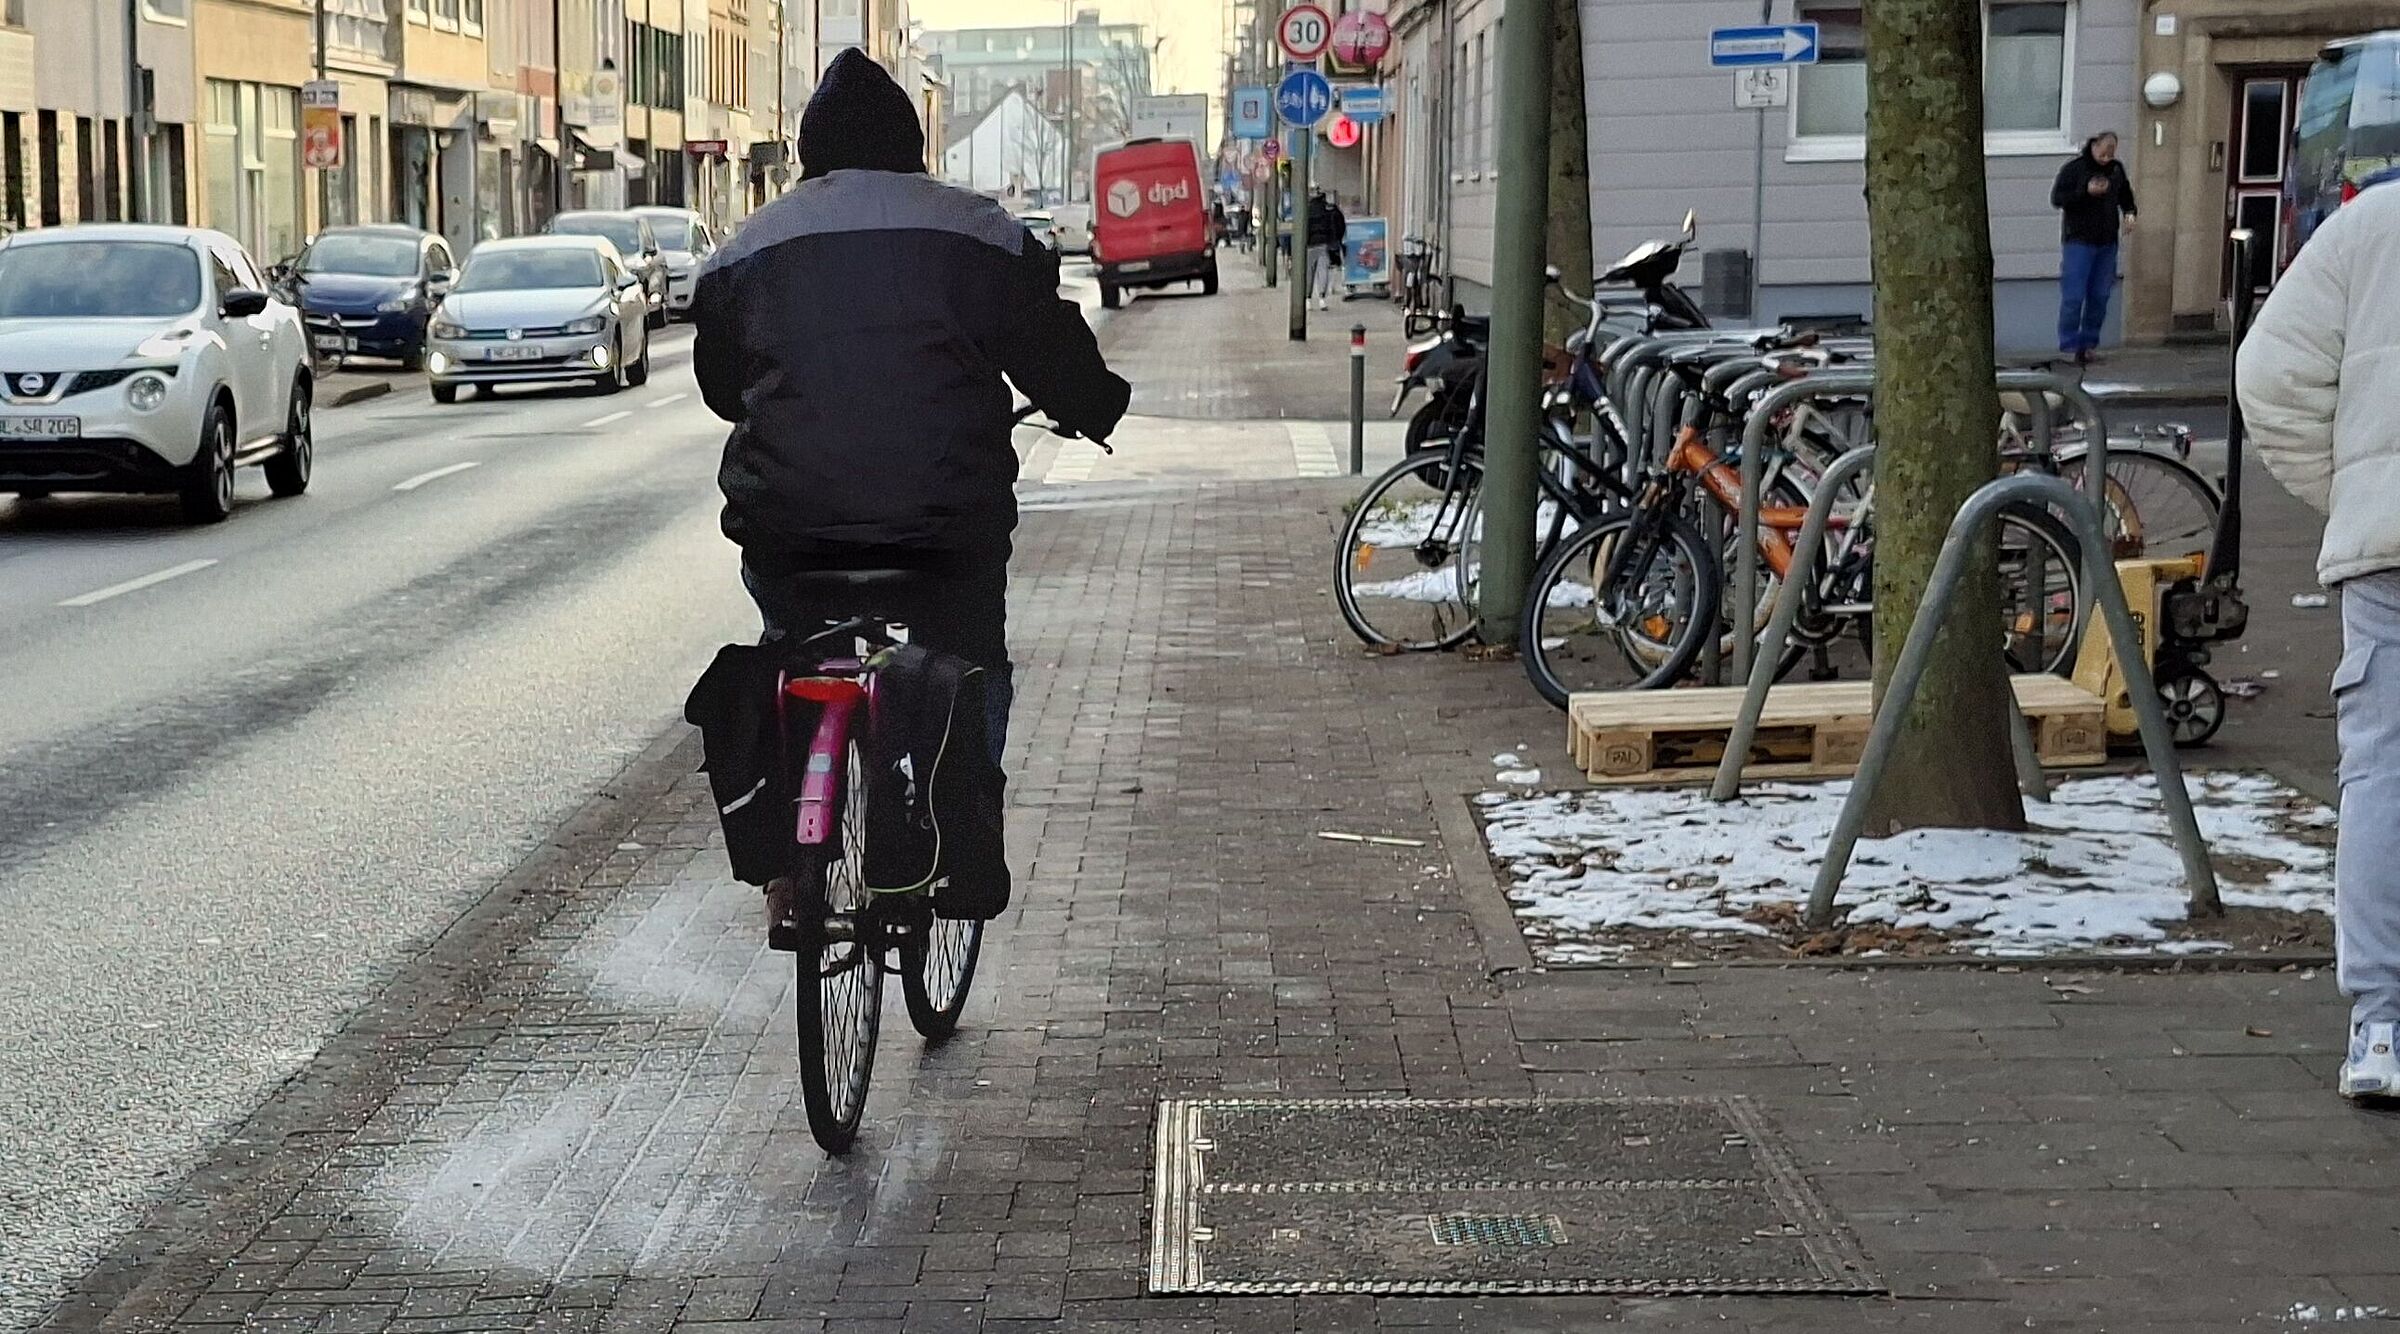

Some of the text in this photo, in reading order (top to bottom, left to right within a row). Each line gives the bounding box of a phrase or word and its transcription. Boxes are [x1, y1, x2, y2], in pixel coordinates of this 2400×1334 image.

[1289, 20, 1320, 44] 30
[1147, 177, 1188, 206] dpd
[48, 418, 76, 434] 205
